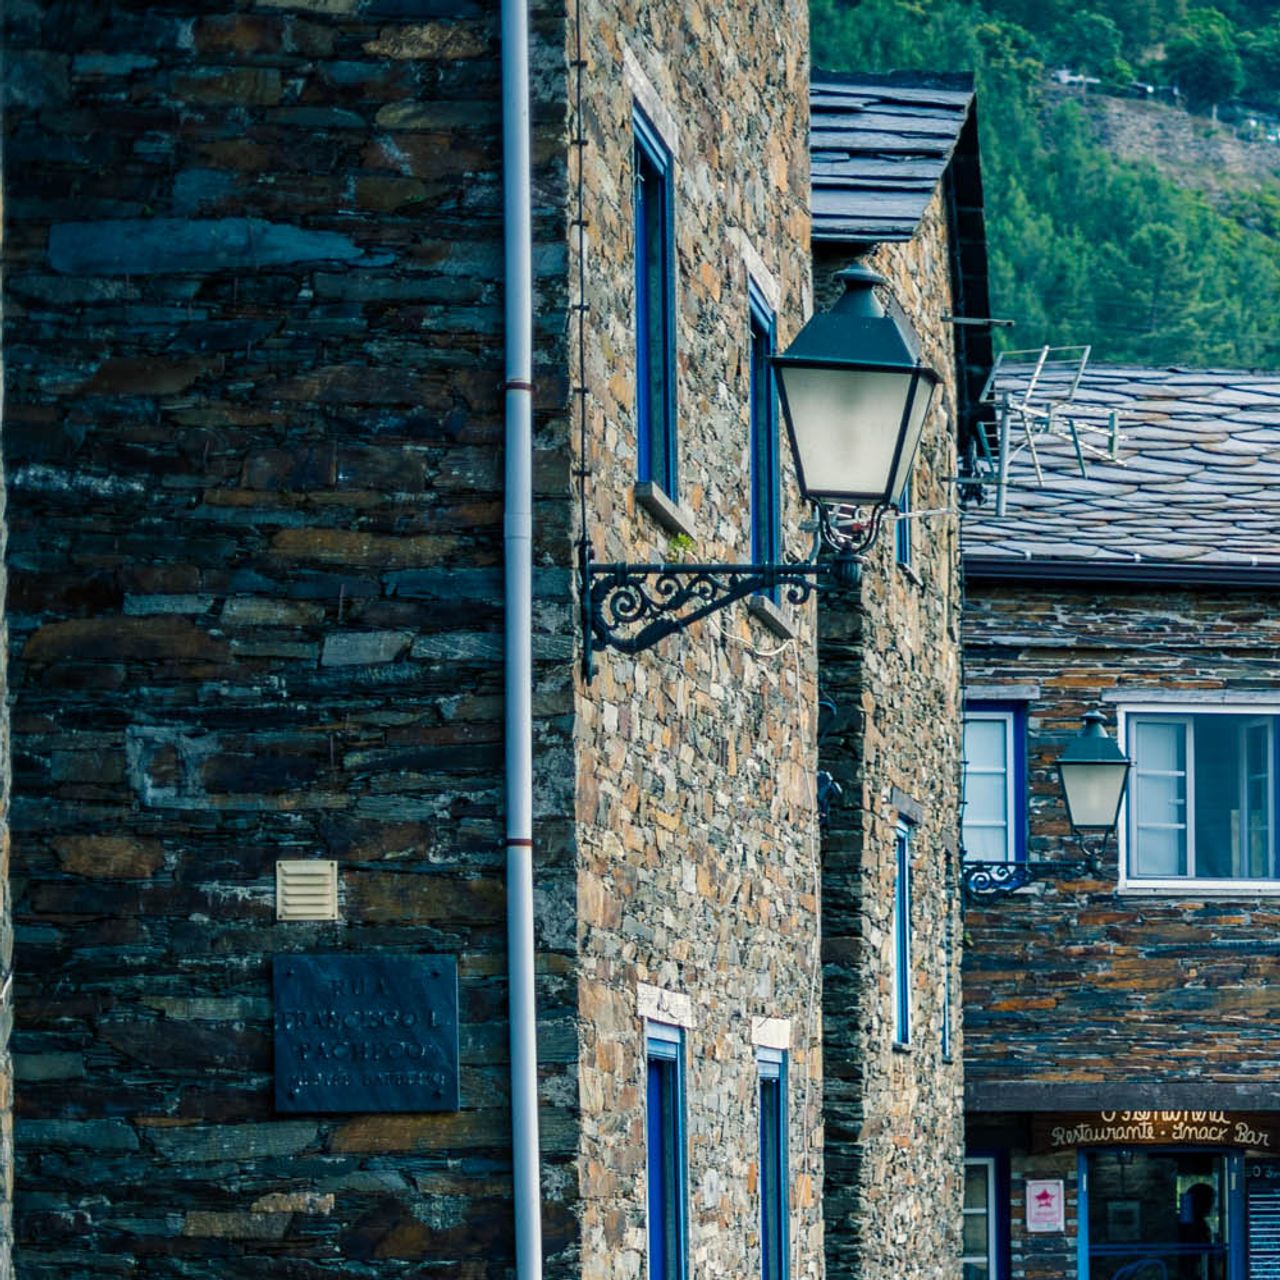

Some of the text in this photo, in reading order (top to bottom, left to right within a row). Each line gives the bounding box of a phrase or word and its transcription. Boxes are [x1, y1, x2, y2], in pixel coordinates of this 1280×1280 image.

[1051, 1120, 1271, 1147] Restaurante Snack Bar
